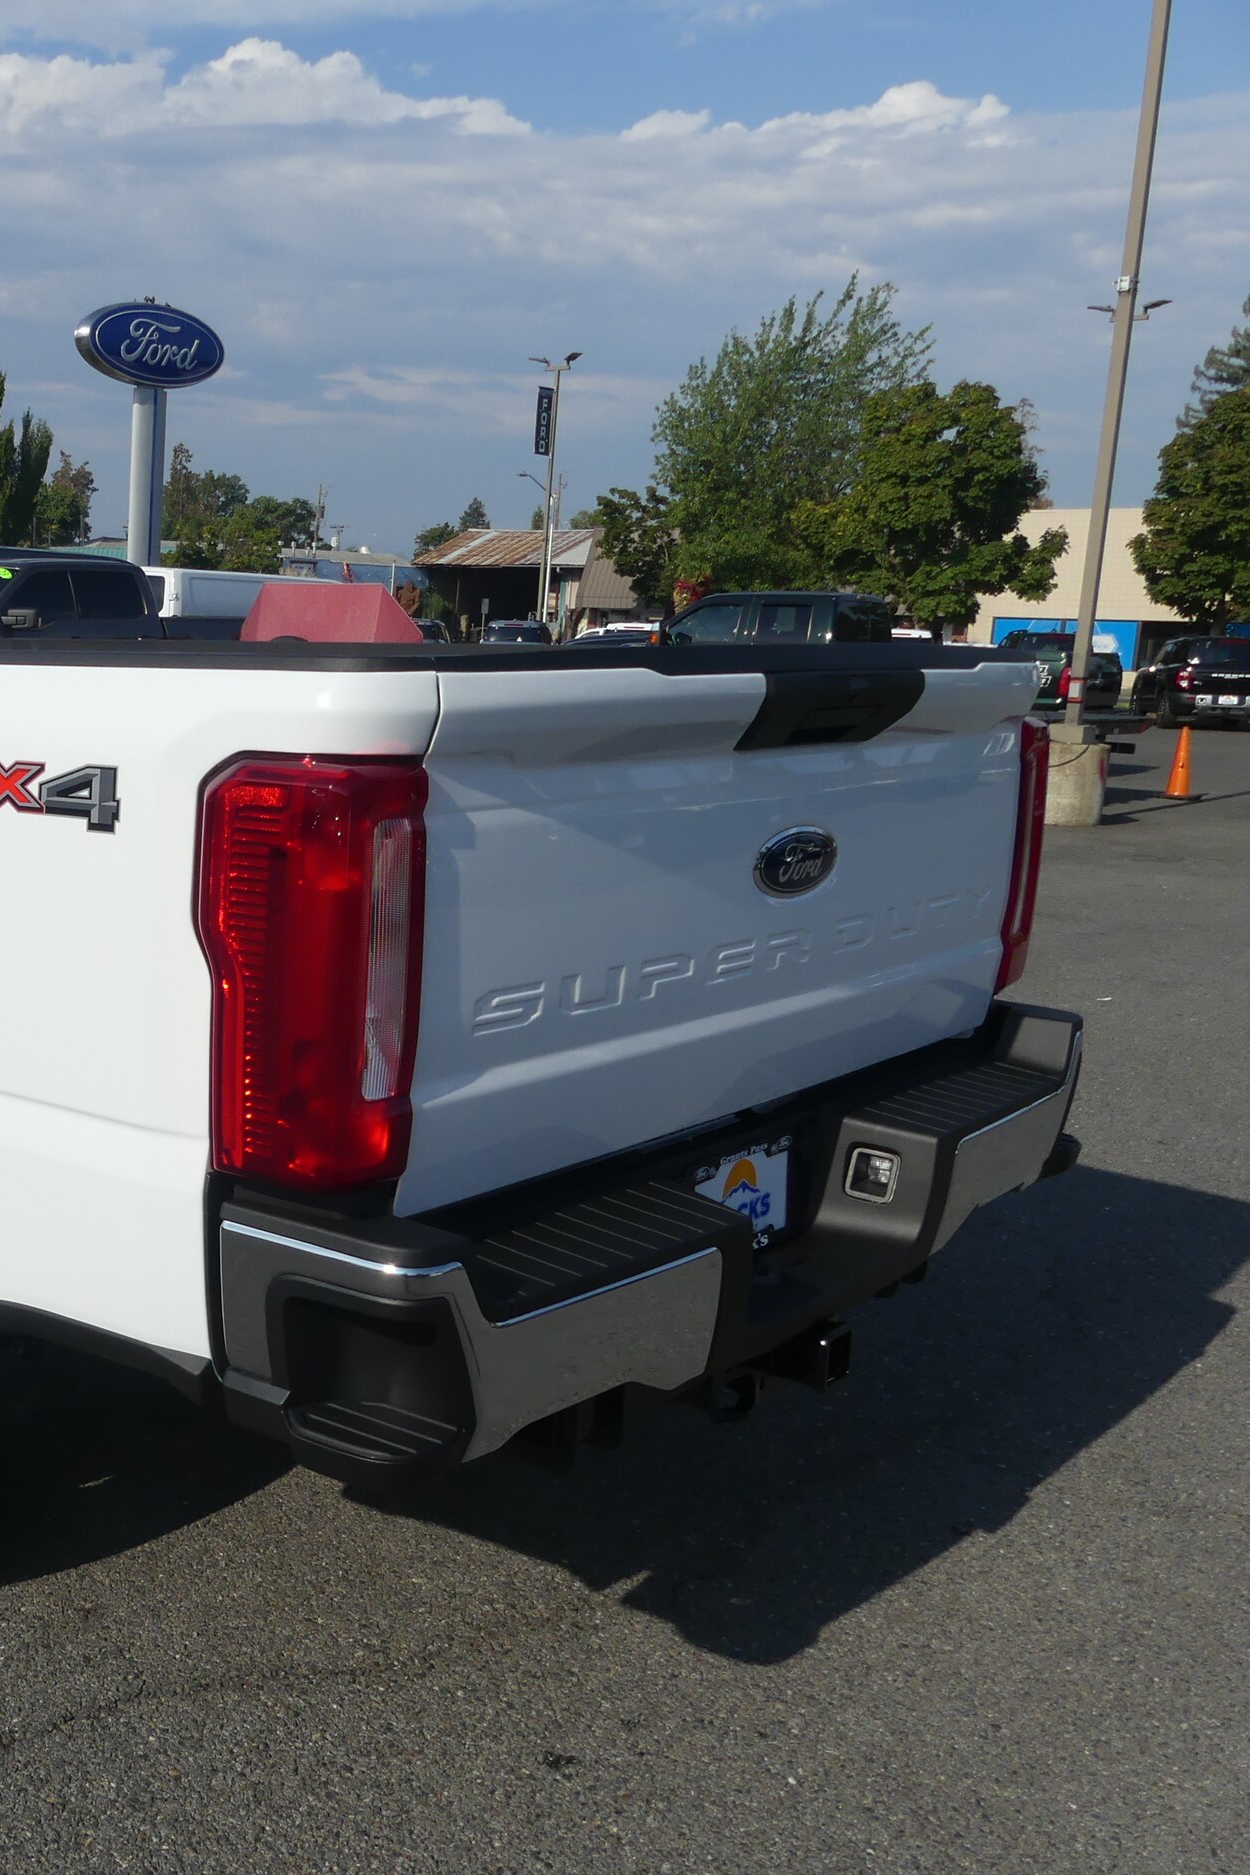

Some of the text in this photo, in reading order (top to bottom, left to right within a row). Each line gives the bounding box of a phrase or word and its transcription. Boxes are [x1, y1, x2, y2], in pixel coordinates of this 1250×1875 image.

[121, 318, 199, 370] Ford
[538, 398, 548, 453] FORD
[778, 843, 823, 883] Ford
[472, 886, 995, 1037] SUPER DUTY
[720, 1143, 768, 1165] Grants Pass
